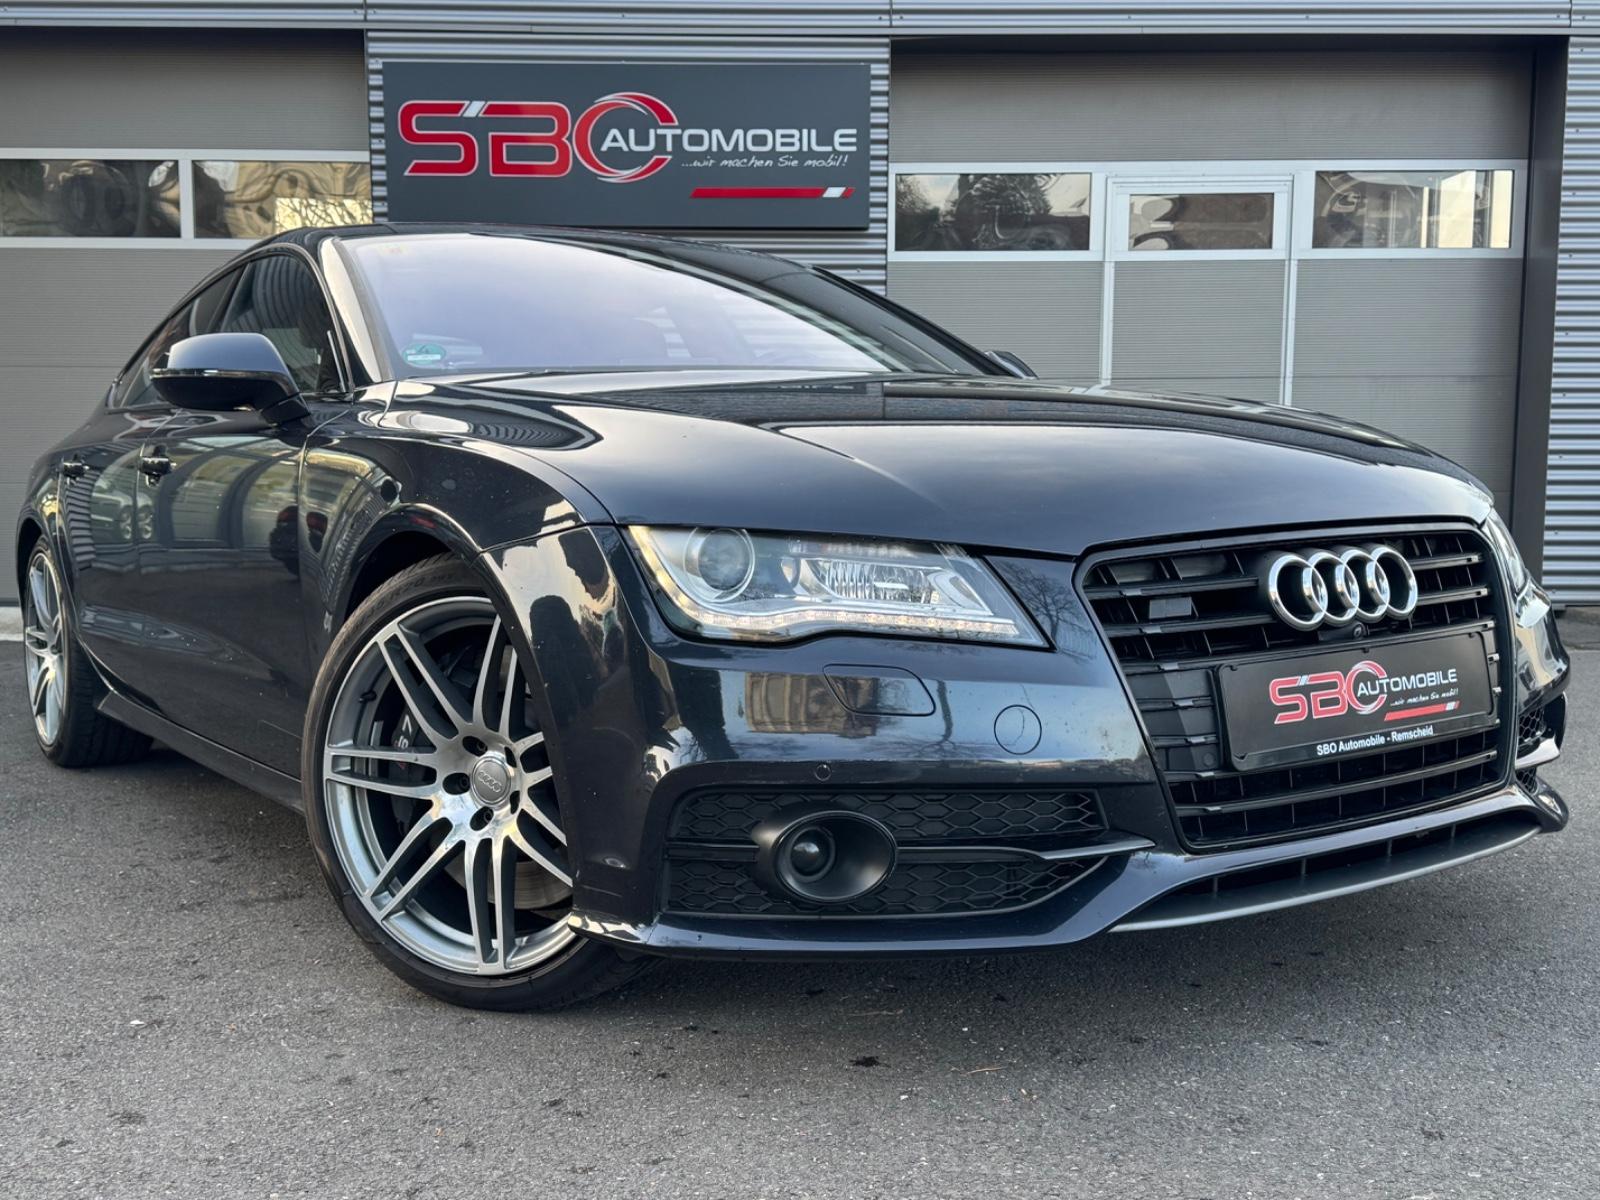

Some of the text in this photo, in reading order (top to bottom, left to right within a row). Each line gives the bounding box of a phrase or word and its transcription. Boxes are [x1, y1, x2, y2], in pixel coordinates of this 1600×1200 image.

[600, 128, 857, 152] AUTOMOBILE
[720, 155, 773, 168] machen
[777, 155, 799, 167] Sie
[804, 155, 848, 167] mobil!
[1357, 668, 1458, 697] AUTOMOBILE
[1316, 743, 1337, 756] SBO
[1339, 734, 1385, 752] Automobile
[1391, 725, 1434, 742] Remscheid
